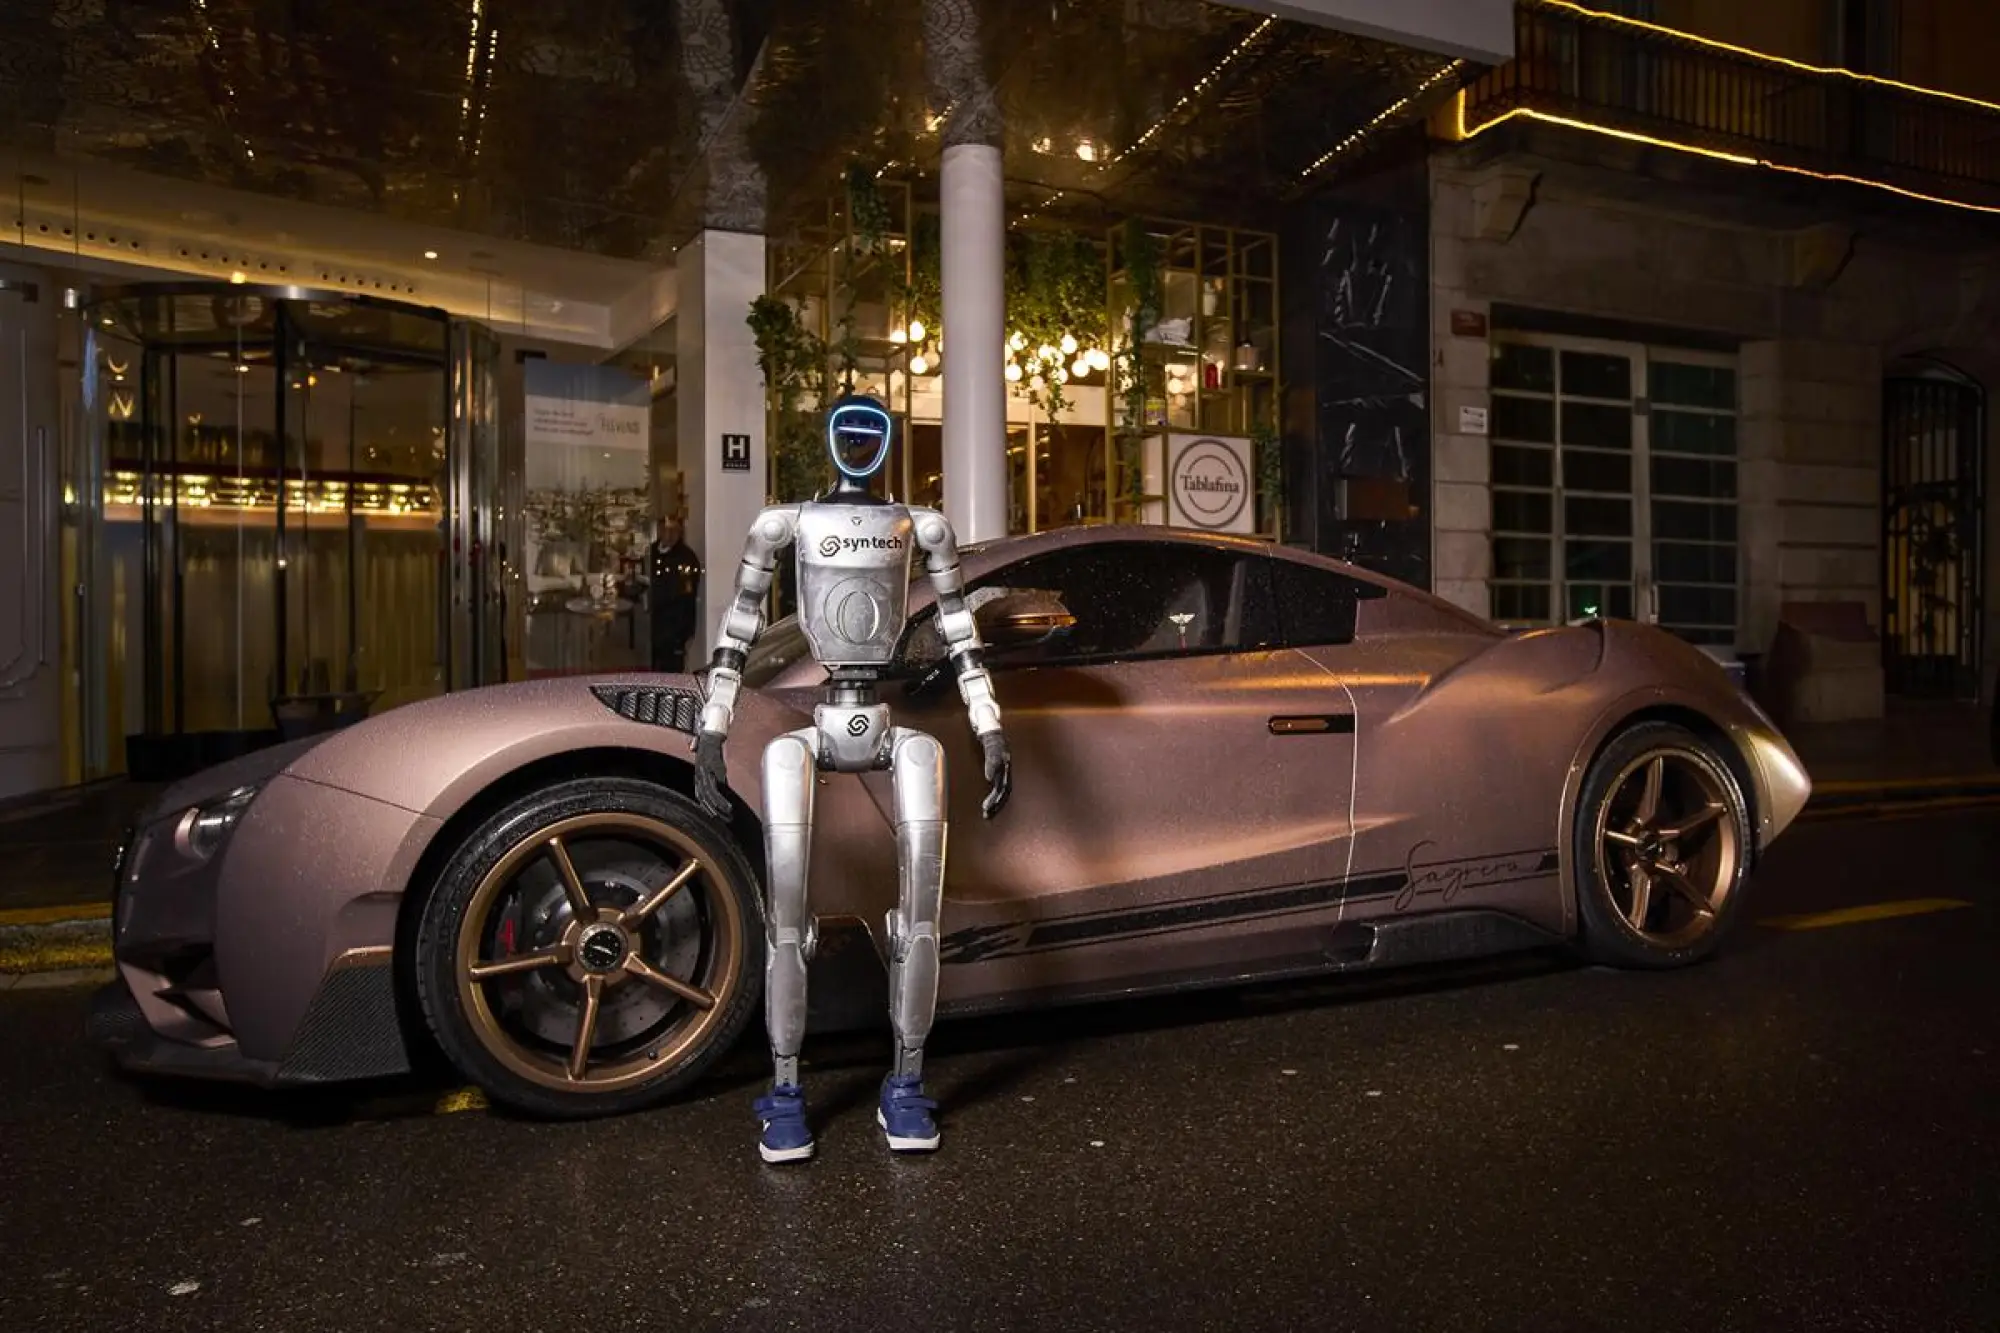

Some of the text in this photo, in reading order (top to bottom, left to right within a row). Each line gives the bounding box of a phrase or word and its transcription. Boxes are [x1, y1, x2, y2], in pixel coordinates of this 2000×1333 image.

[728, 436, 745, 458] H
[1180, 475, 1239, 493] Tablafina
[842, 536, 902, 552] syntech
